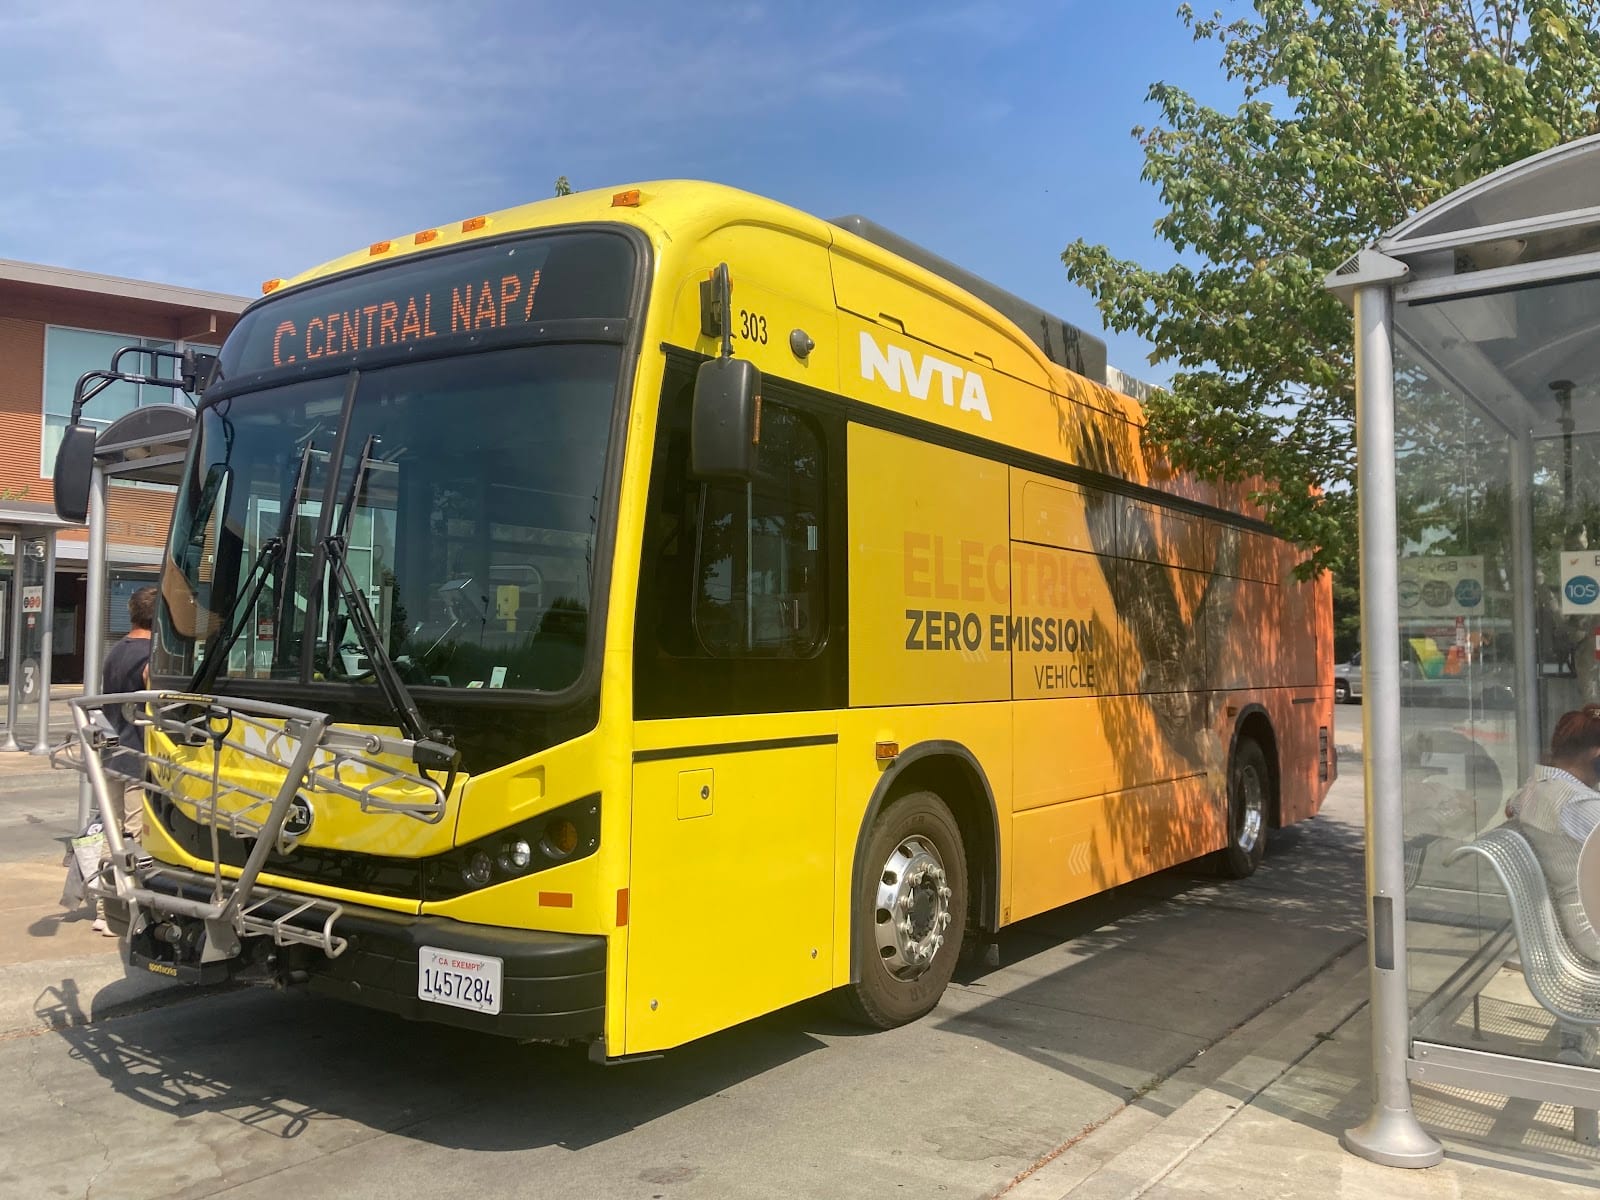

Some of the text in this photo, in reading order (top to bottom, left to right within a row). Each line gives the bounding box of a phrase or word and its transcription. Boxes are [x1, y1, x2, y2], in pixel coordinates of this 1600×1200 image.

[272, 320, 297, 367] C
[305, 293, 437, 360] CENTRAL
[740, 309, 768, 345] 303
[859, 330, 992, 422] NVTA
[903, 531, 1095, 609] ELECTRIC
[1567, 583, 1596, 598] 10S
[905, 609, 1094, 652] ZERO EMISSION
[23, 666, 34, 694] 3
[1034, 664, 1095, 690] VEHICLE
[438, 957, 480, 972] CA EXEMPT
[424, 968, 493, 1006] 1457284
